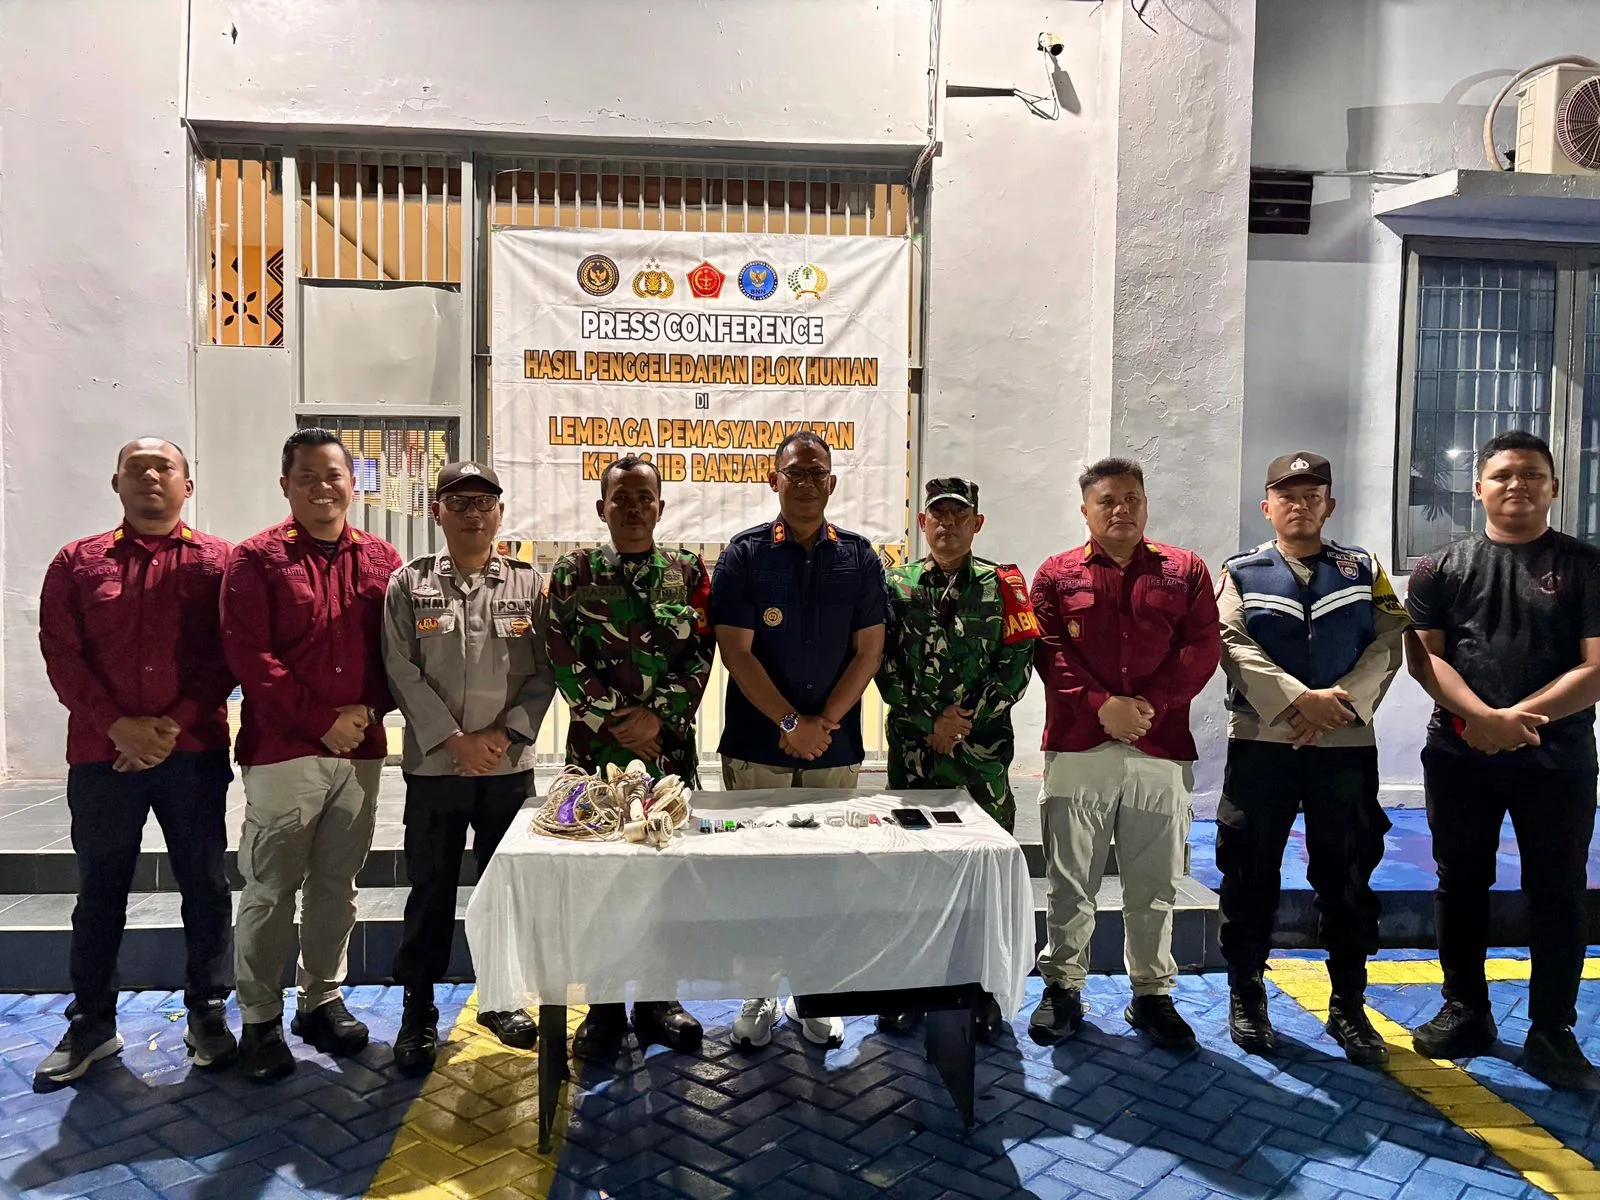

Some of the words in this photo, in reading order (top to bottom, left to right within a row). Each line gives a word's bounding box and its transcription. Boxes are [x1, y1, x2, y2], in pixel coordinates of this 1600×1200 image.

[581, 311, 660, 341] PRESS
[663, 312, 824, 344] CONFERENCE
[524, 349, 582, 380] HASIL
[585, 350, 748, 384] PENGGELEDAHAN
[752, 355, 804, 385] BLOK
[806, 356, 878, 386] HUNIAN
[695, 393, 709, 409] DI
[549, 416, 655, 447] LEMBAGA
